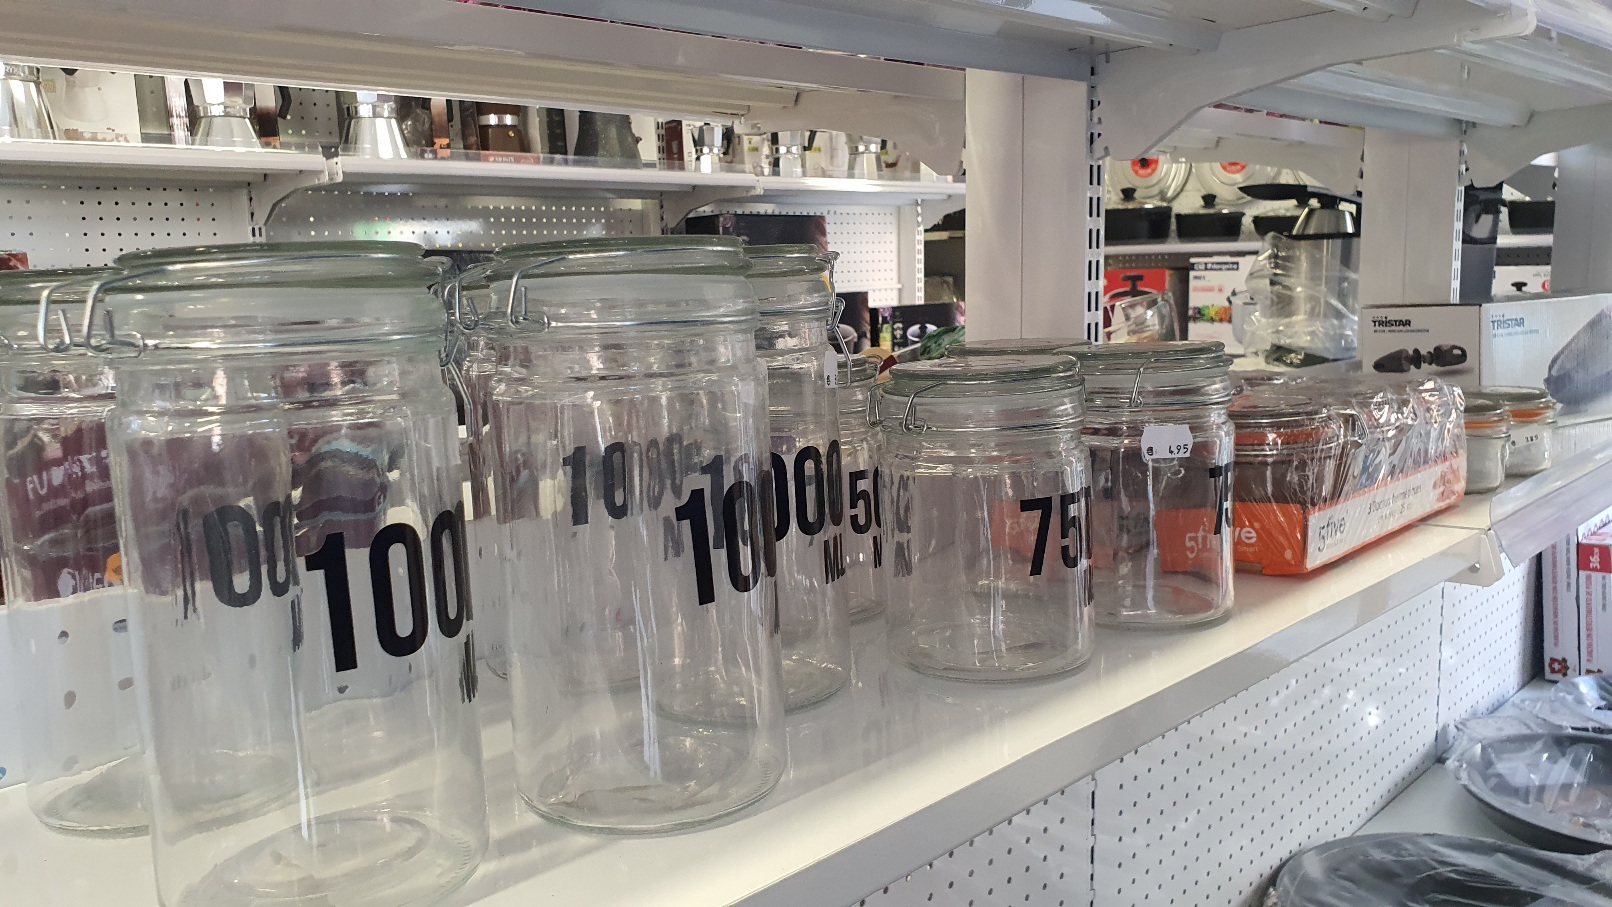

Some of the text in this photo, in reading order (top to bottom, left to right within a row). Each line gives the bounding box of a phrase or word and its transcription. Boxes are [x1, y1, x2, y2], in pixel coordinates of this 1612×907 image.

[1371, 317, 1412, 328] TRISTAR
[1491, 316, 1525, 330] TRISTAR
[1317, 513, 1347, 553] 5five
